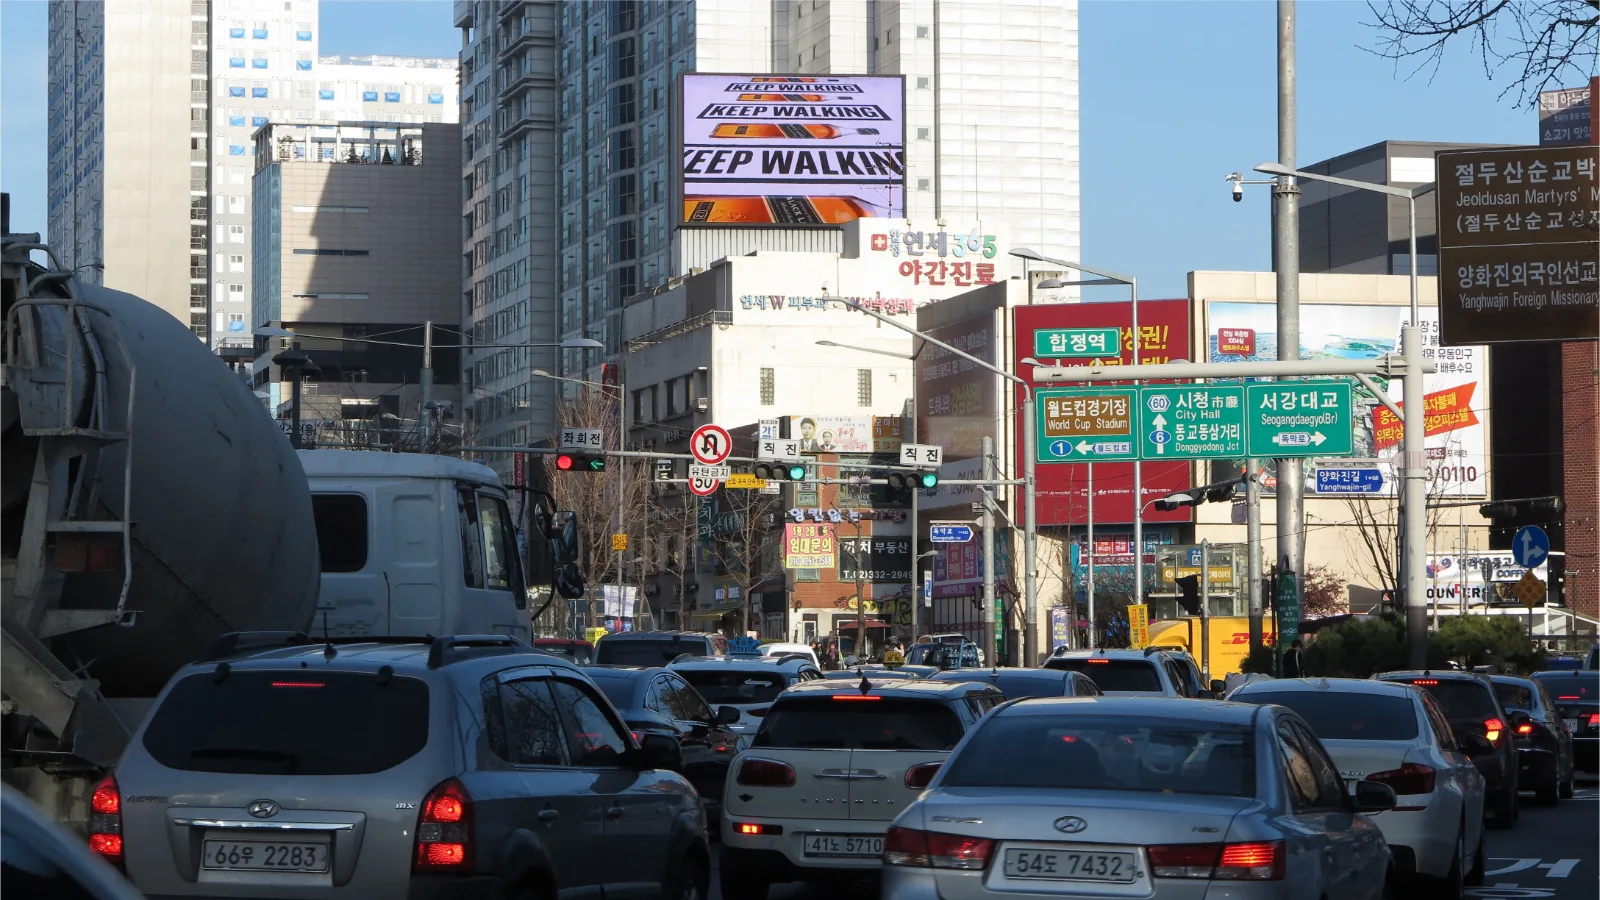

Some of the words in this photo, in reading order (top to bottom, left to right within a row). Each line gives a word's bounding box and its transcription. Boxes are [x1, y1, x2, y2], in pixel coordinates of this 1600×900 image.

[779, 84, 857, 92] WALKING
[709, 105, 767, 116] KEEP
[773, 105, 879, 118] WALKING
[1456, 191, 1520, 207] Jeoldusan
[1525, 187, 1581, 206] Martyrs'
[898, 259, 998, 287] 야간진료
[1459, 293, 1509, 312] Yanghwajin
[1513, 291, 1547, 310] Foreign
[1049, 333, 1106, 352] 합정역
[1437, 348, 1473, 360] 유동인구
[1440, 362, 1473, 373] 배후수요
[1152, 398, 1165, 408] 60
[1176, 391, 1209, 409] 시청
[1260, 391, 1339, 410] 서강대교
[1047, 399, 1127, 418] 월드컵경기장
[1175, 410, 1197, 421] City
[1200, 410, 1221, 419] Hall
[1048, 419, 1070, 430] World
[1074, 419, 1091, 431] Cup
[1096, 417, 1128, 429] Stadium
[563, 431, 601, 445] 좌회전
[1156, 431, 1164, 442] 6
[1175, 423, 1240, 441] 동교동삼거리
[1281, 434, 1306, 443] 독막로
[1057, 442, 1064, 454] 1
[1096, 444, 1128, 452] 월드컵로
[1175, 442, 1224, 453] Donggyodong
[1226, 442, 1239, 451] Jct
[691, 467, 729, 477] 유턴금지
[1319, 471, 1360, 482] 양화진길
[695, 478, 713, 488] 50
[1319, 484, 1372, 492] Yanghwajin-gil
[790, 538, 833, 553] 임대문의
[812, 837, 840, 852] 41노
[846, 838, 883, 853] 5710
[215, 844, 254, 866] 66우
[263, 846, 317, 867] 2283
[1016, 852, 1058, 873] 54도
[1067, 855, 1123, 877] 7432
